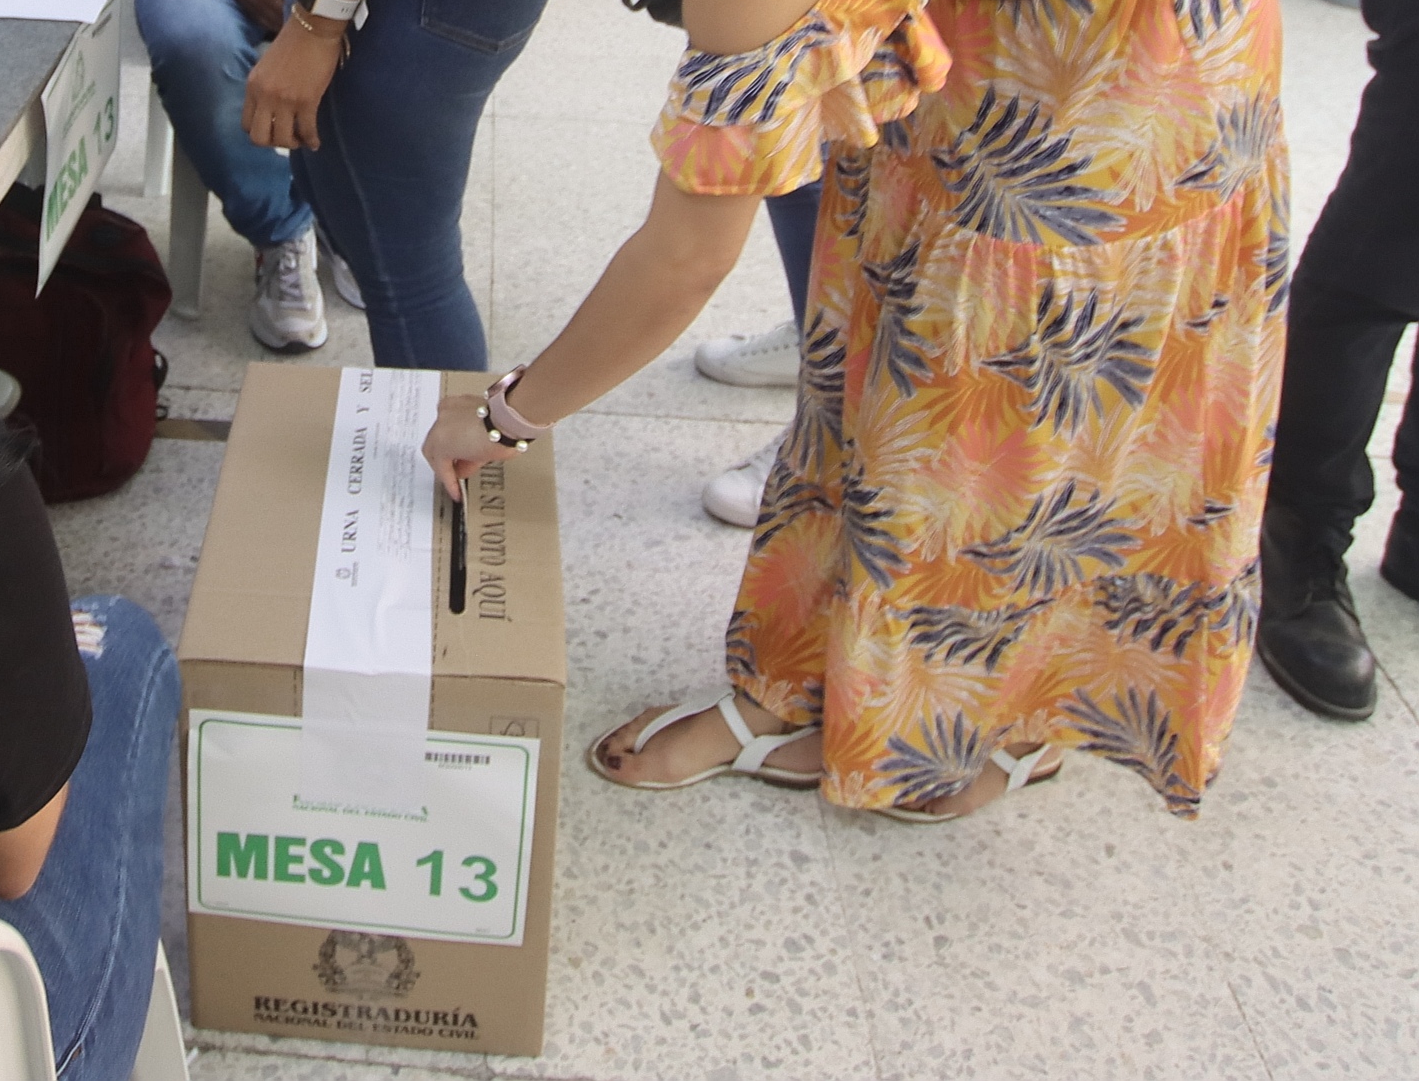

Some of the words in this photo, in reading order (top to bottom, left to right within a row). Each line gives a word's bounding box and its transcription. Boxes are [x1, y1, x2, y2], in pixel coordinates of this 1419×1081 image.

[46, 135, 89, 242] MESA
[93, 96, 114, 156] 13
[356, 404, 370, 414] Y
[347, 427, 368, 495] CERRADA
[480, 494, 505, 517] SU
[341, 509, 360, 554] URNA
[480, 522, 506, 566] VOTO
[215, 831, 387, 890] MESA
[416, 849, 499, 903] 13
[253, 996, 479, 1028] REGISTRADURÍA
[337, 1020, 364, 1031] DEL
[372, 1022, 434, 1036] ESTADO
[438, 1028, 479, 1041] CIVIL
